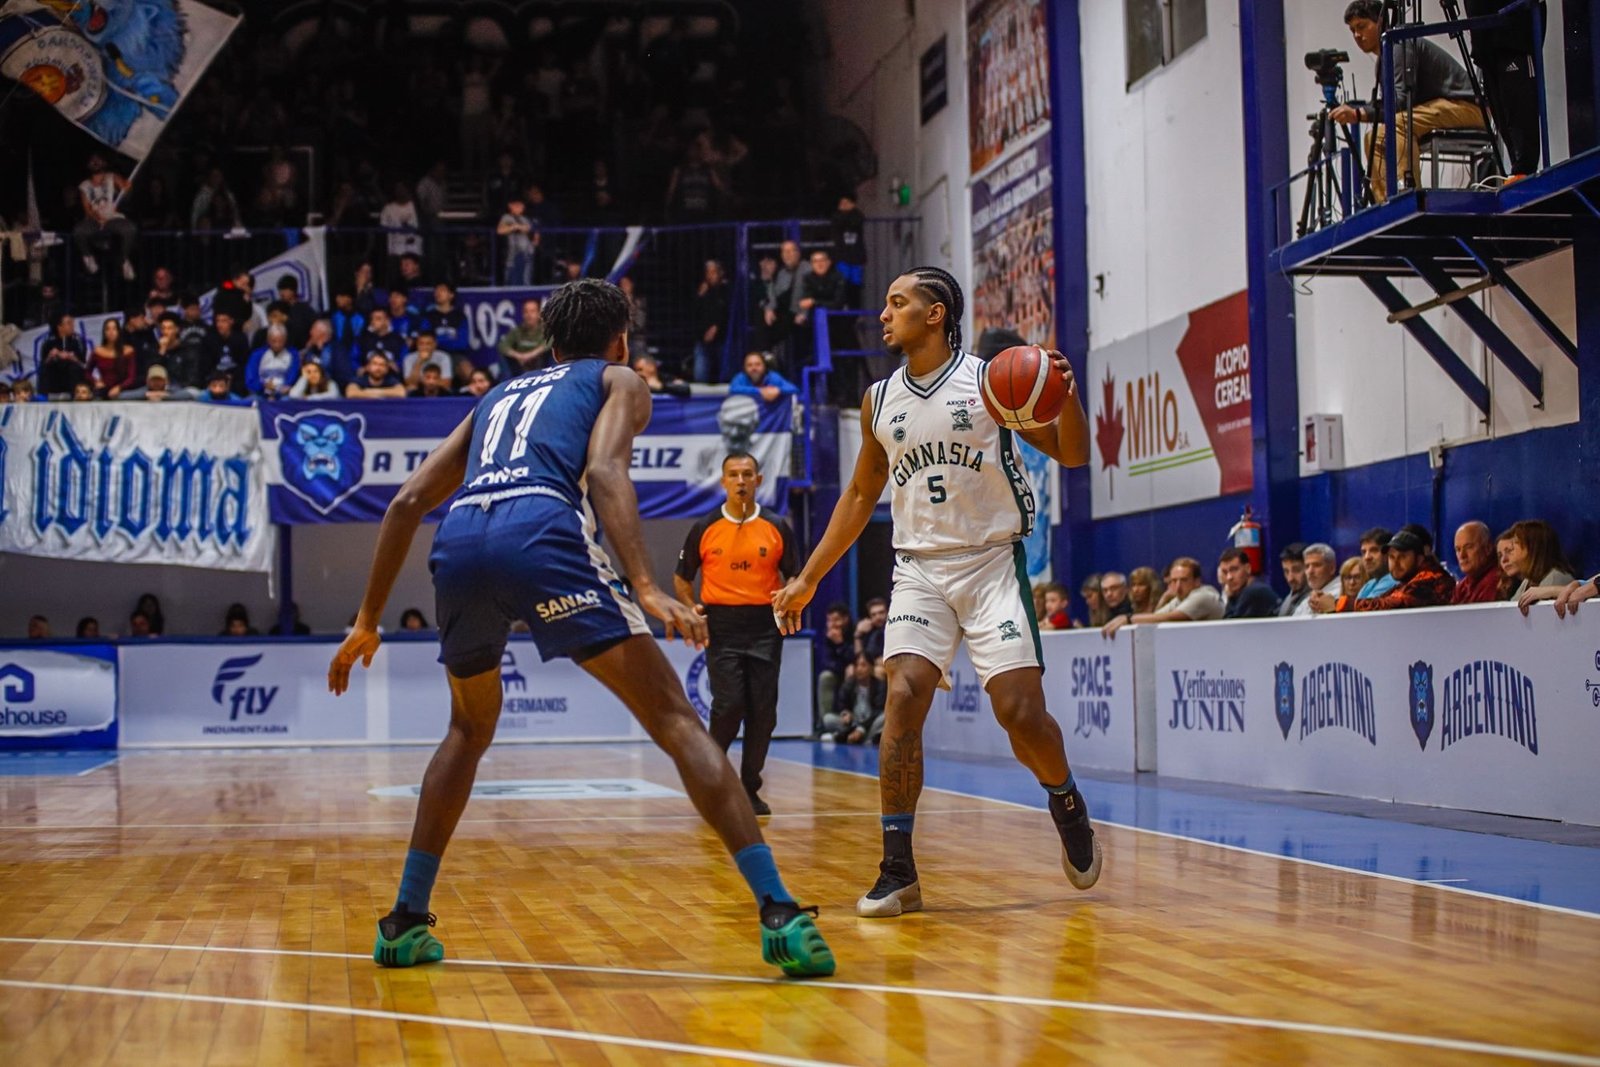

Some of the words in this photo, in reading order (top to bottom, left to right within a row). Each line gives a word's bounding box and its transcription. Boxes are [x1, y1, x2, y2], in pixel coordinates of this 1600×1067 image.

[1214, 344, 1249, 378] ACOPIO
[504, 367, 571, 392] REYES
[480, 385, 553, 467] 11
[1126, 370, 1178, 461] Milo
[372, 451, 391, 472] A
[404, 451, 429, 472] T
[631, 448, 683, 468] ELIZ
[893, 441, 983, 487] GIMNASIA
[34, 410, 252, 547] idioma
[927, 475, 947, 504] 5
[536, 589, 601, 619] SANAR
[1071, 655, 1113, 697] SPACE
[1171, 670, 1246, 705] Verificaciones
[229, 686, 279, 721] fly
[504, 698, 567, 713] HERMANOS
[1074, 701, 1111, 738] JUMP
[1169, 699, 1245, 733] JUNIN
[1300, 662, 1376, 746] ARGENTINO
[1441, 660, 1538, 756] ARGENTINO
